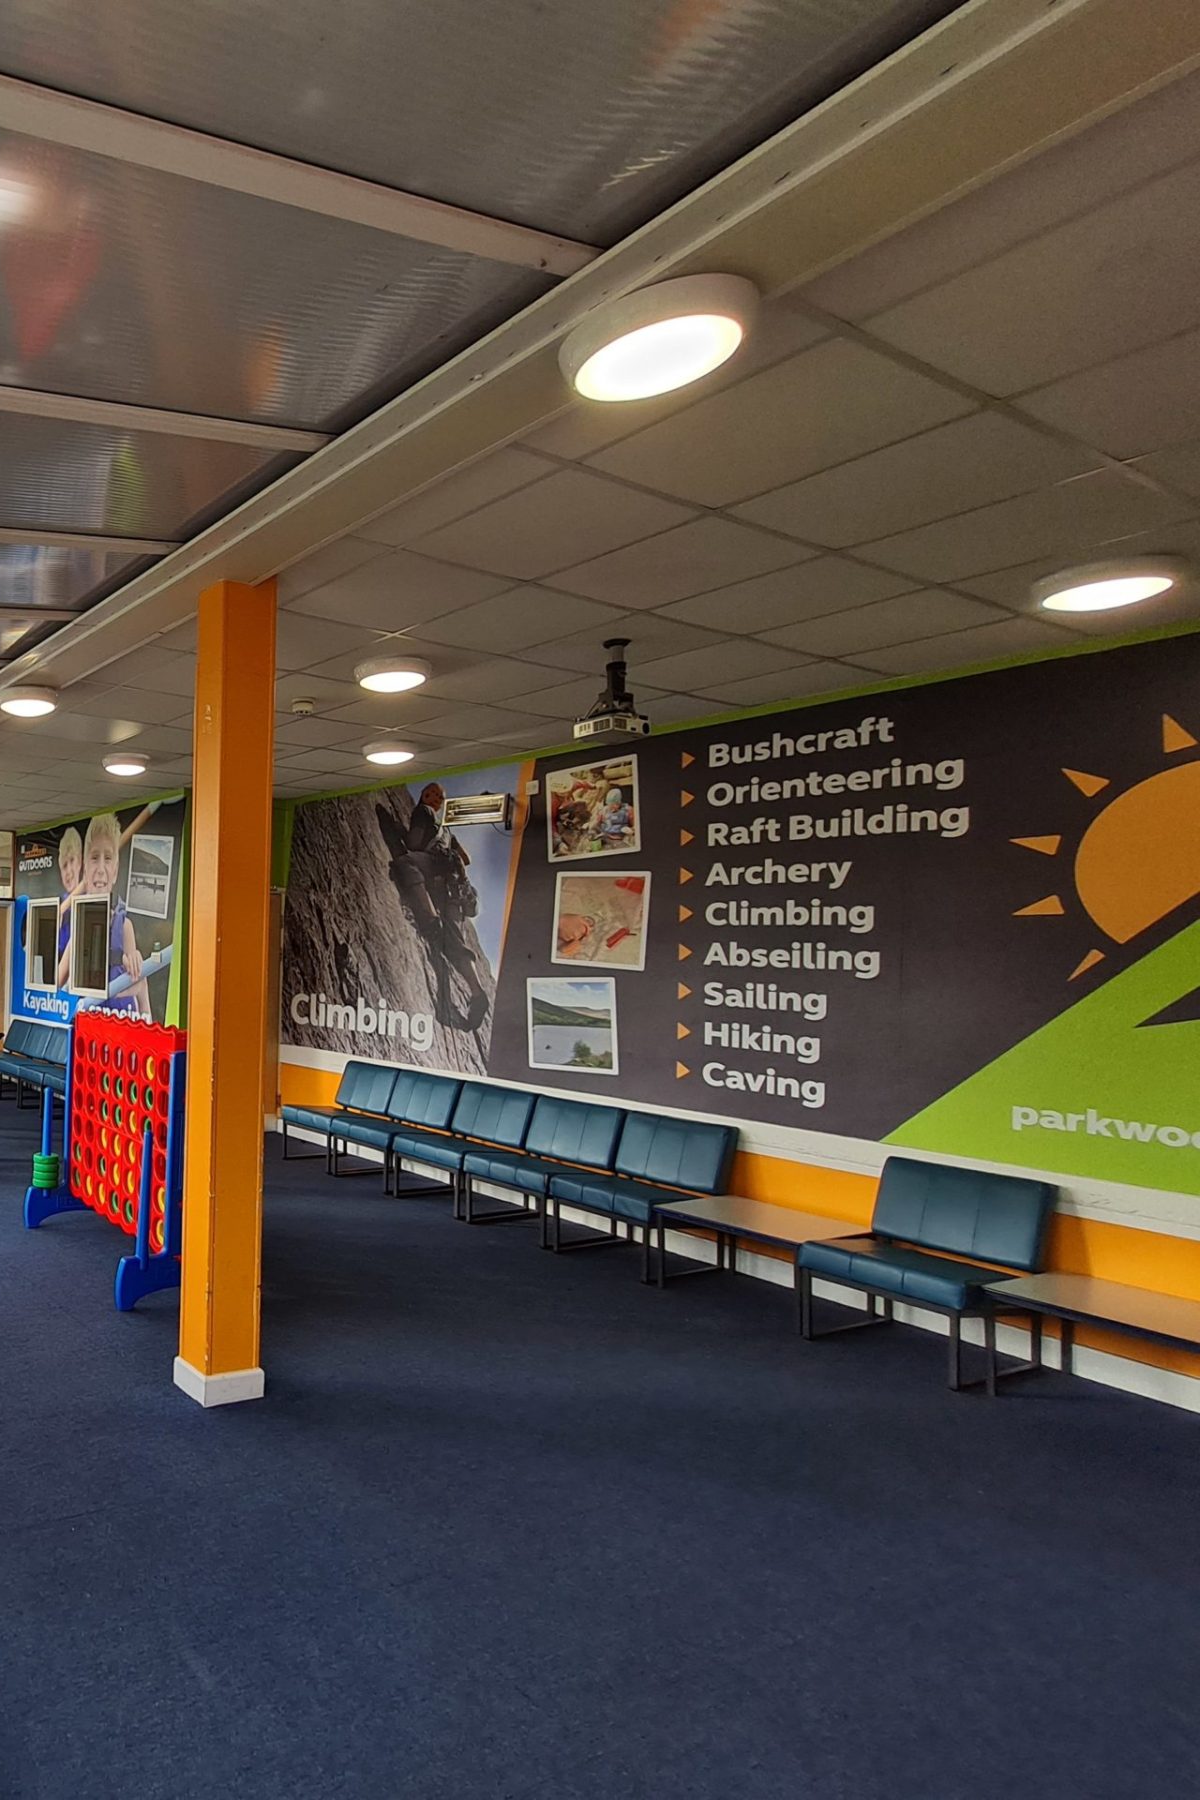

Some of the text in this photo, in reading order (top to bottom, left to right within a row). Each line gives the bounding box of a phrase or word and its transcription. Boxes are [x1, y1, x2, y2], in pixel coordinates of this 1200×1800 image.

[707, 717, 894, 769] Bushcraft
[706, 758, 965, 807] Orienteering
[706, 804, 970, 847] Raft Building
[19, 856, 53, 872] OUTDOORS
[705, 857, 852, 889] Archery
[704, 899, 876, 933] Climbing
[703, 941, 881, 979] Abseiling
[23, 990, 69, 1020] Kayaking
[290, 993, 434, 1050] Climbing
[703, 981, 828, 1021] Sailing
[704, 1022, 821, 1063] Hiking
[702, 1063, 826, 1108] Caving
[1011, 1105, 1200, 1150] parkwo
